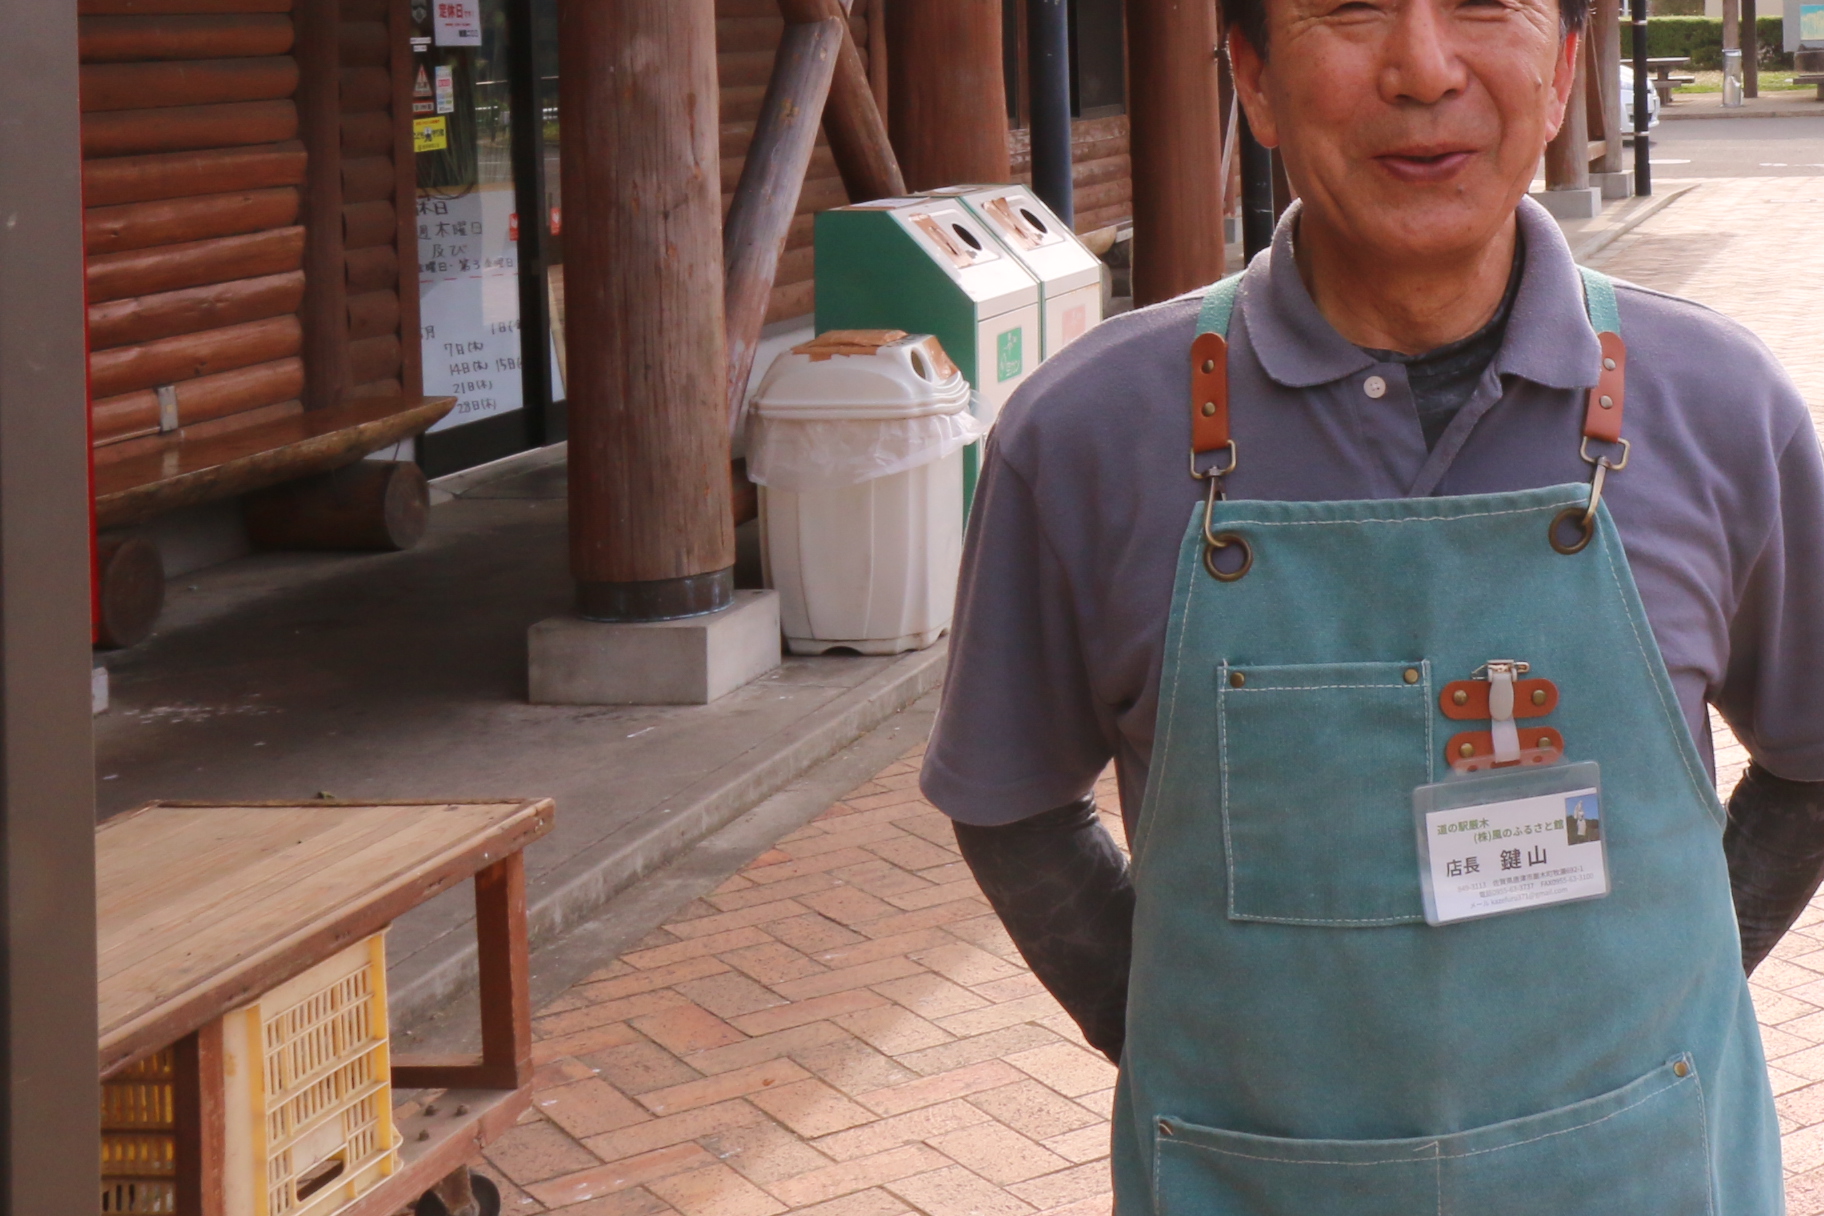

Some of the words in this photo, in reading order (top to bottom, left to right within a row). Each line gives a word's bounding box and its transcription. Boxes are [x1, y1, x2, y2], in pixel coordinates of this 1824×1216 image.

[452, 380, 494, 394] 21日(木)
[1446, 856, 1480, 878] 店長
[1500, 845, 1547, 871] 鍵山
